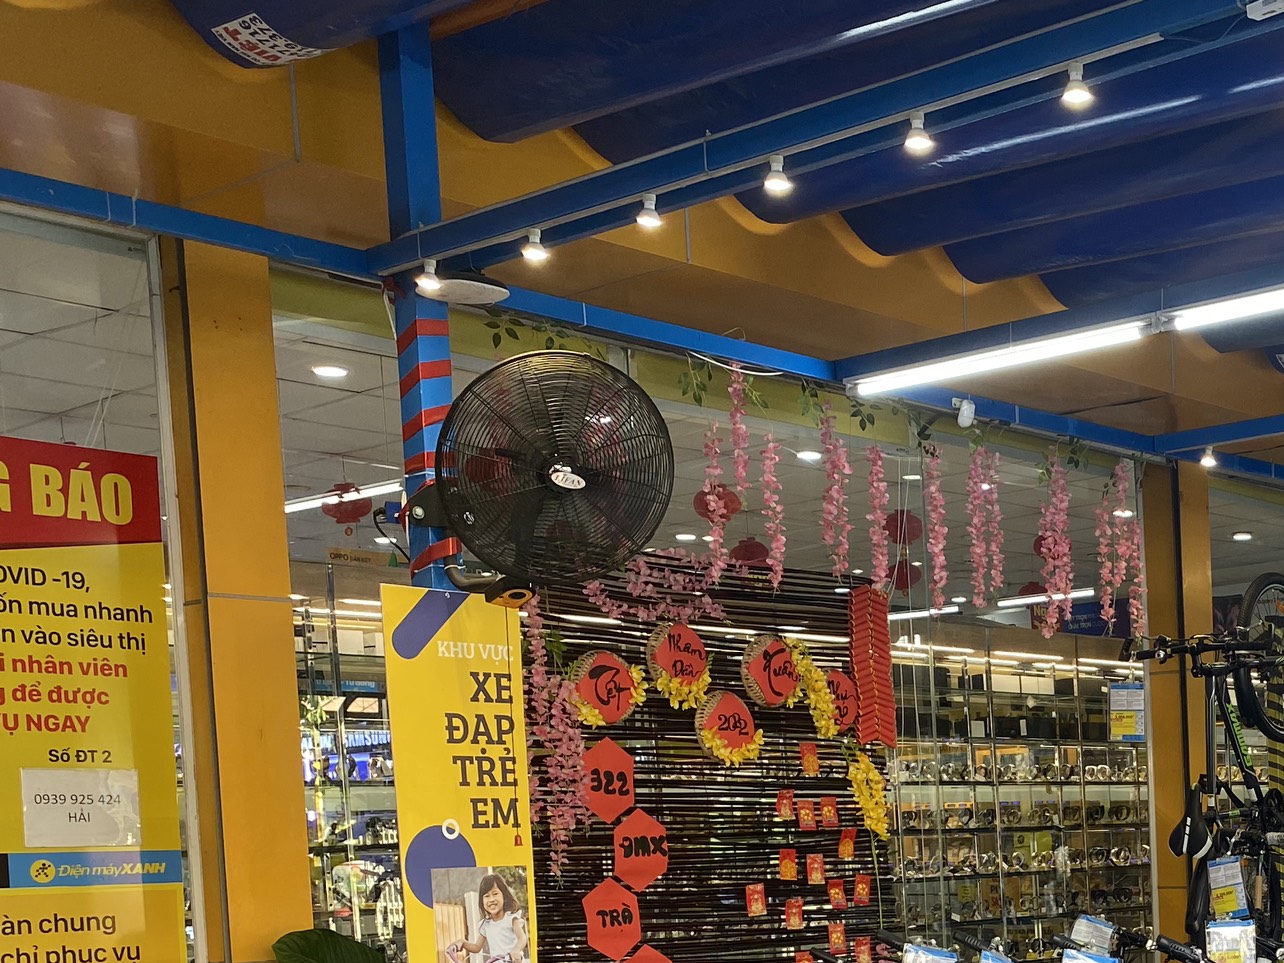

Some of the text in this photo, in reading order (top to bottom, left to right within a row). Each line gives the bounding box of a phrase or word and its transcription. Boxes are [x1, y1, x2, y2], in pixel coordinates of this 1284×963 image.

[30, 462, 134, 526] BÁO
[28, 601, 78, 619] mua
[84, 601, 153, 624] nhanh
[20, 625, 61, 646] vào
[67, 628, 113, 650] siêu
[118, 632, 147, 656] thị
[437, 640, 514, 666] KHU VỰC
[12, 654, 73, 676] nhân
[78, 657, 128, 678] viên
[12, 680, 110, 708] để được
[470, 671, 513, 704] XE
[26, 713, 91, 734] NGAY
[444, 712, 515, 755] ĐẠP
[48, 748, 112, 764] Số ĐT 2
[452, 747, 519, 788] TRẺ
[590, 767, 630, 797] 322
[34, 794, 121, 805] 0939 925 424
[68, 808, 91, 823] HẢI
[470, 797, 521, 829] EM
[58, 863, 91, 878] Điện
[39, 913, 117, 935] chung
[596, 902, 633, 928] TRÀ
[112, 945, 141, 962] vụ
